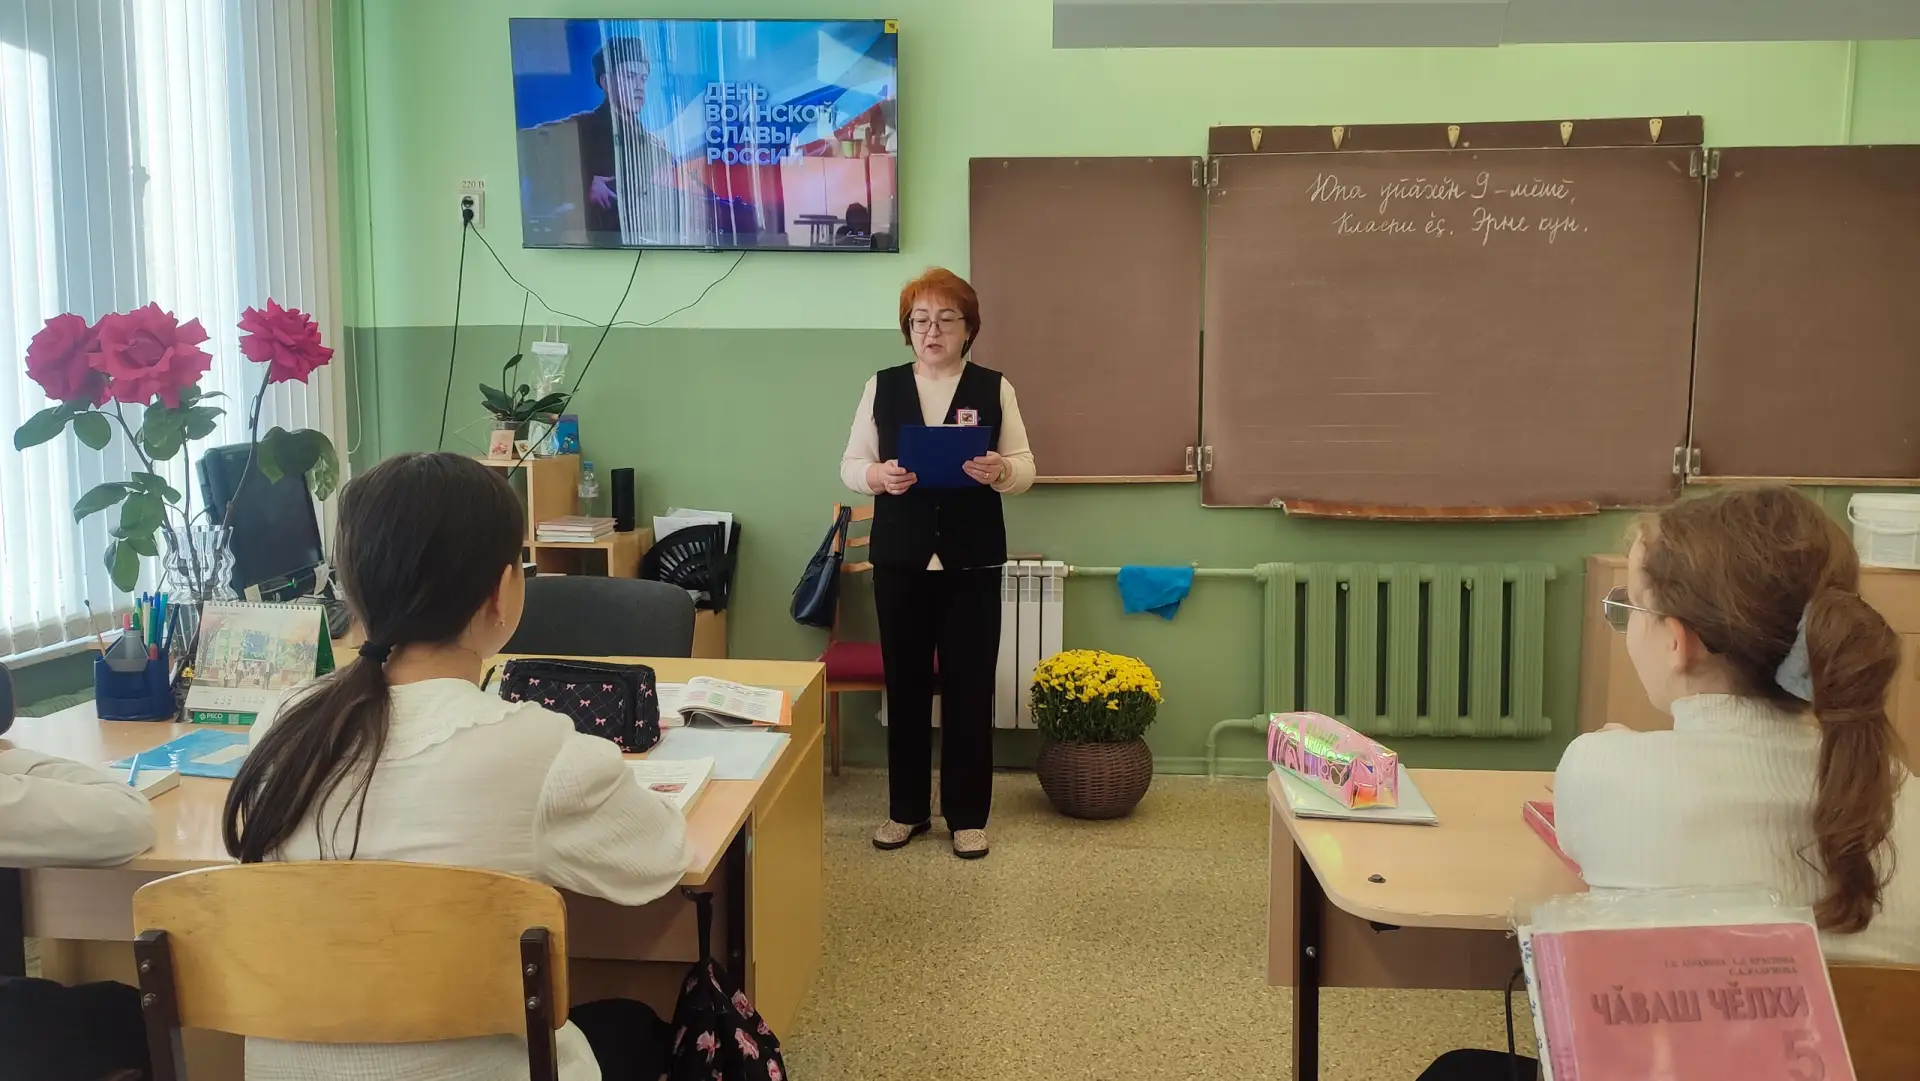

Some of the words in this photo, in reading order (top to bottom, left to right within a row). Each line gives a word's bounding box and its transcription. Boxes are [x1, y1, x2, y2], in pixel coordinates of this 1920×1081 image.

[705, 82, 769, 103] ДЕНЬ
[705, 125, 791, 144] СЛАВЫ
[462, 180, 476, 189] 220
[1306, 173, 1367, 202] Юпа
[1782, 1029, 1825, 1081] 5
